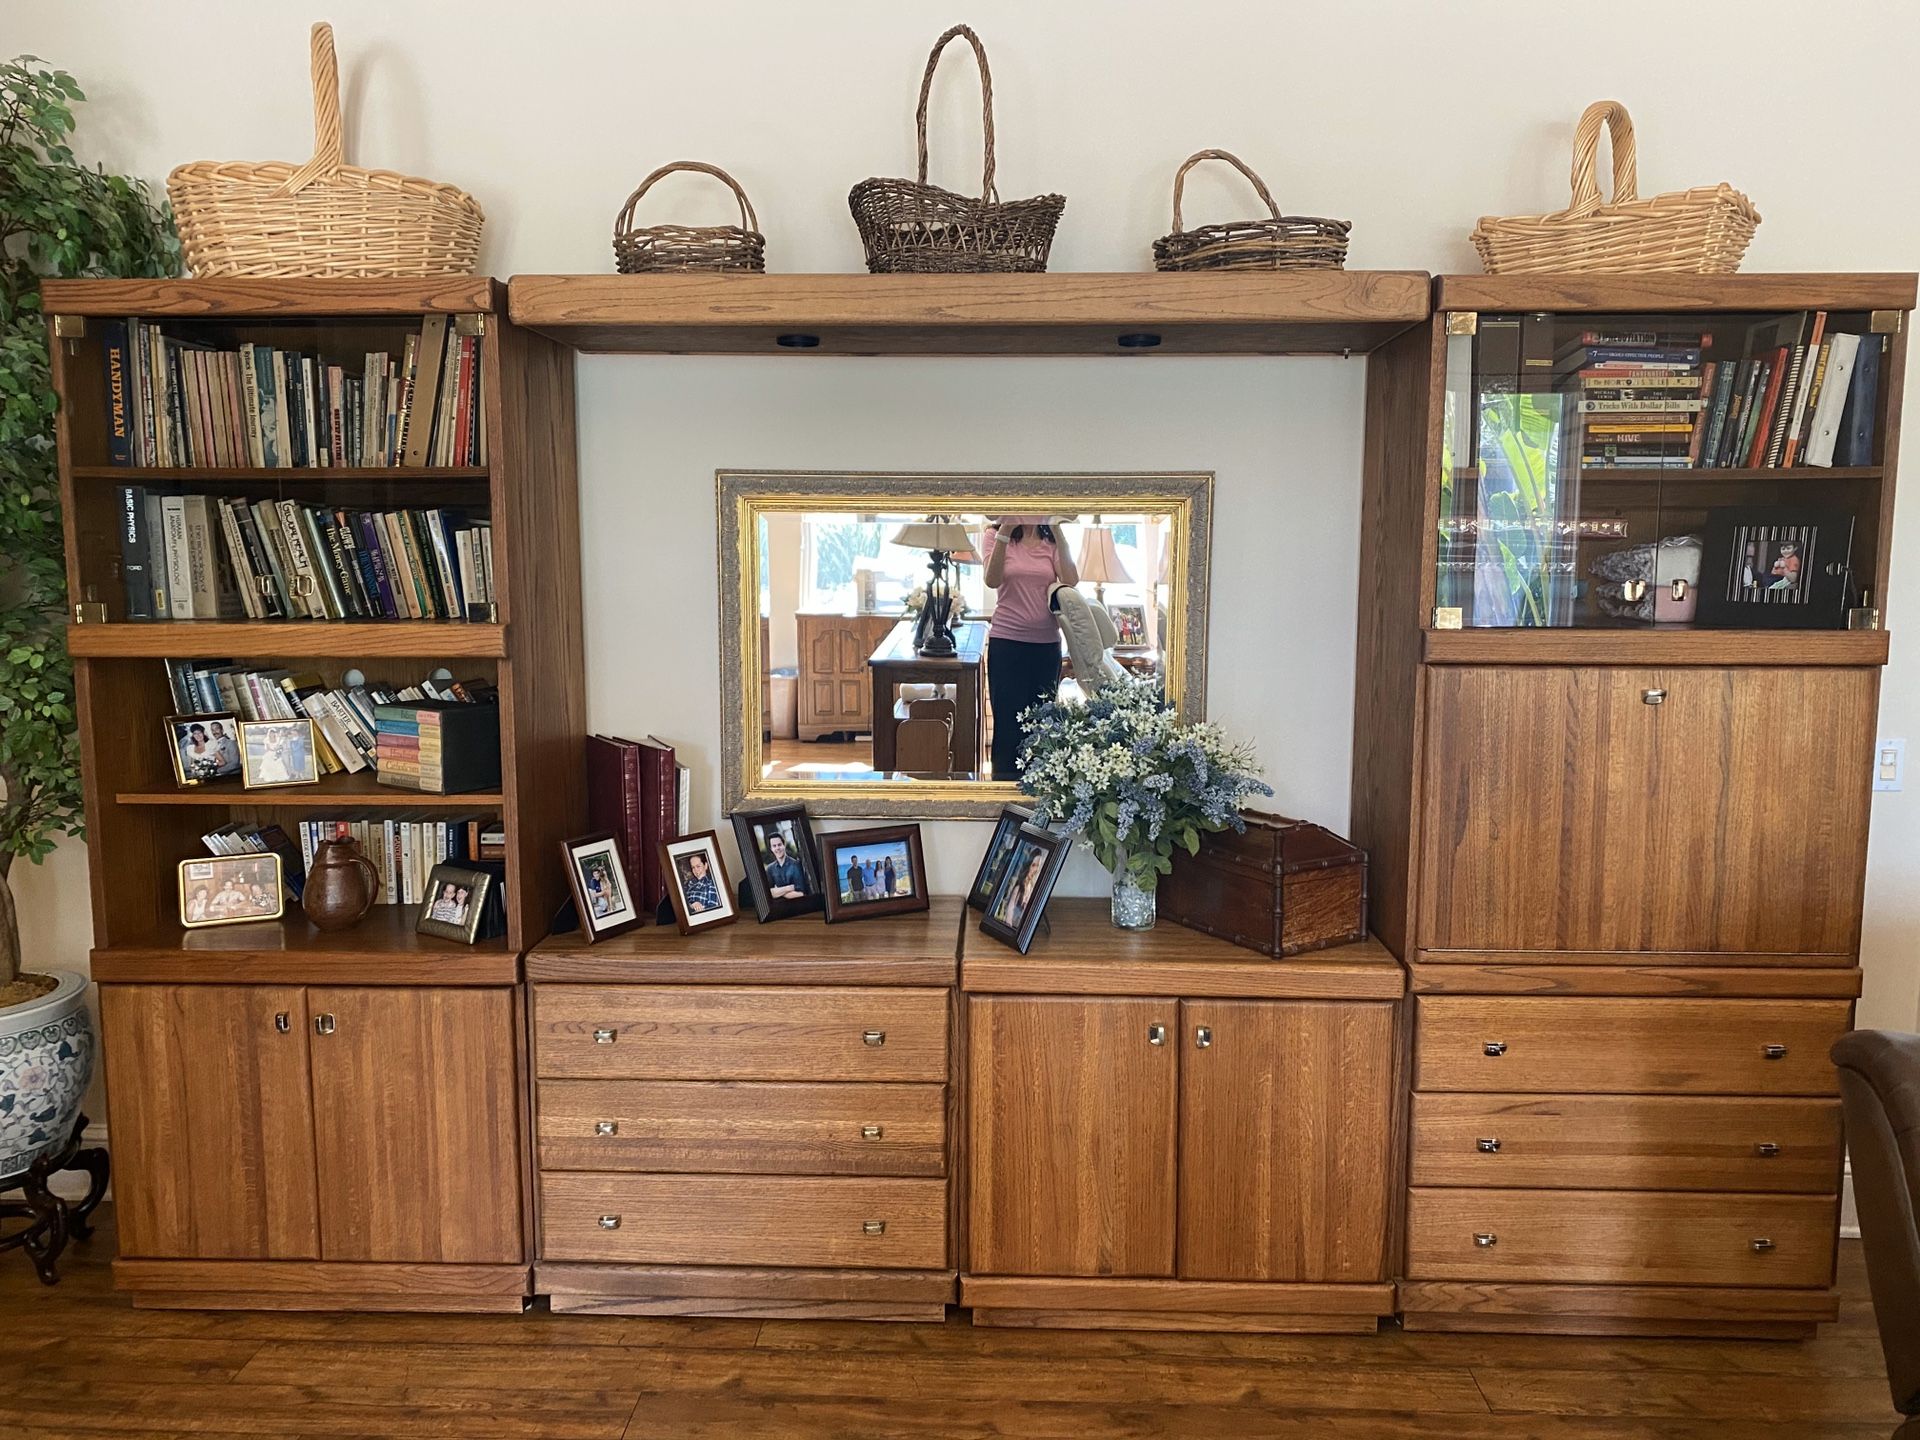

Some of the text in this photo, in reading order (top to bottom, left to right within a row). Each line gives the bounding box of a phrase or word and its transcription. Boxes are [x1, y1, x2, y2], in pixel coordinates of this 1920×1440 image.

[109, 347, 125, 437] HANDYMAN
[249, 413, 257, 438] Journey
[124, 487, 136, 543] BASIC PHYSICS
[325, 526, 354, 596] The Money Game
[330, 699, 351, 725] BARTER
